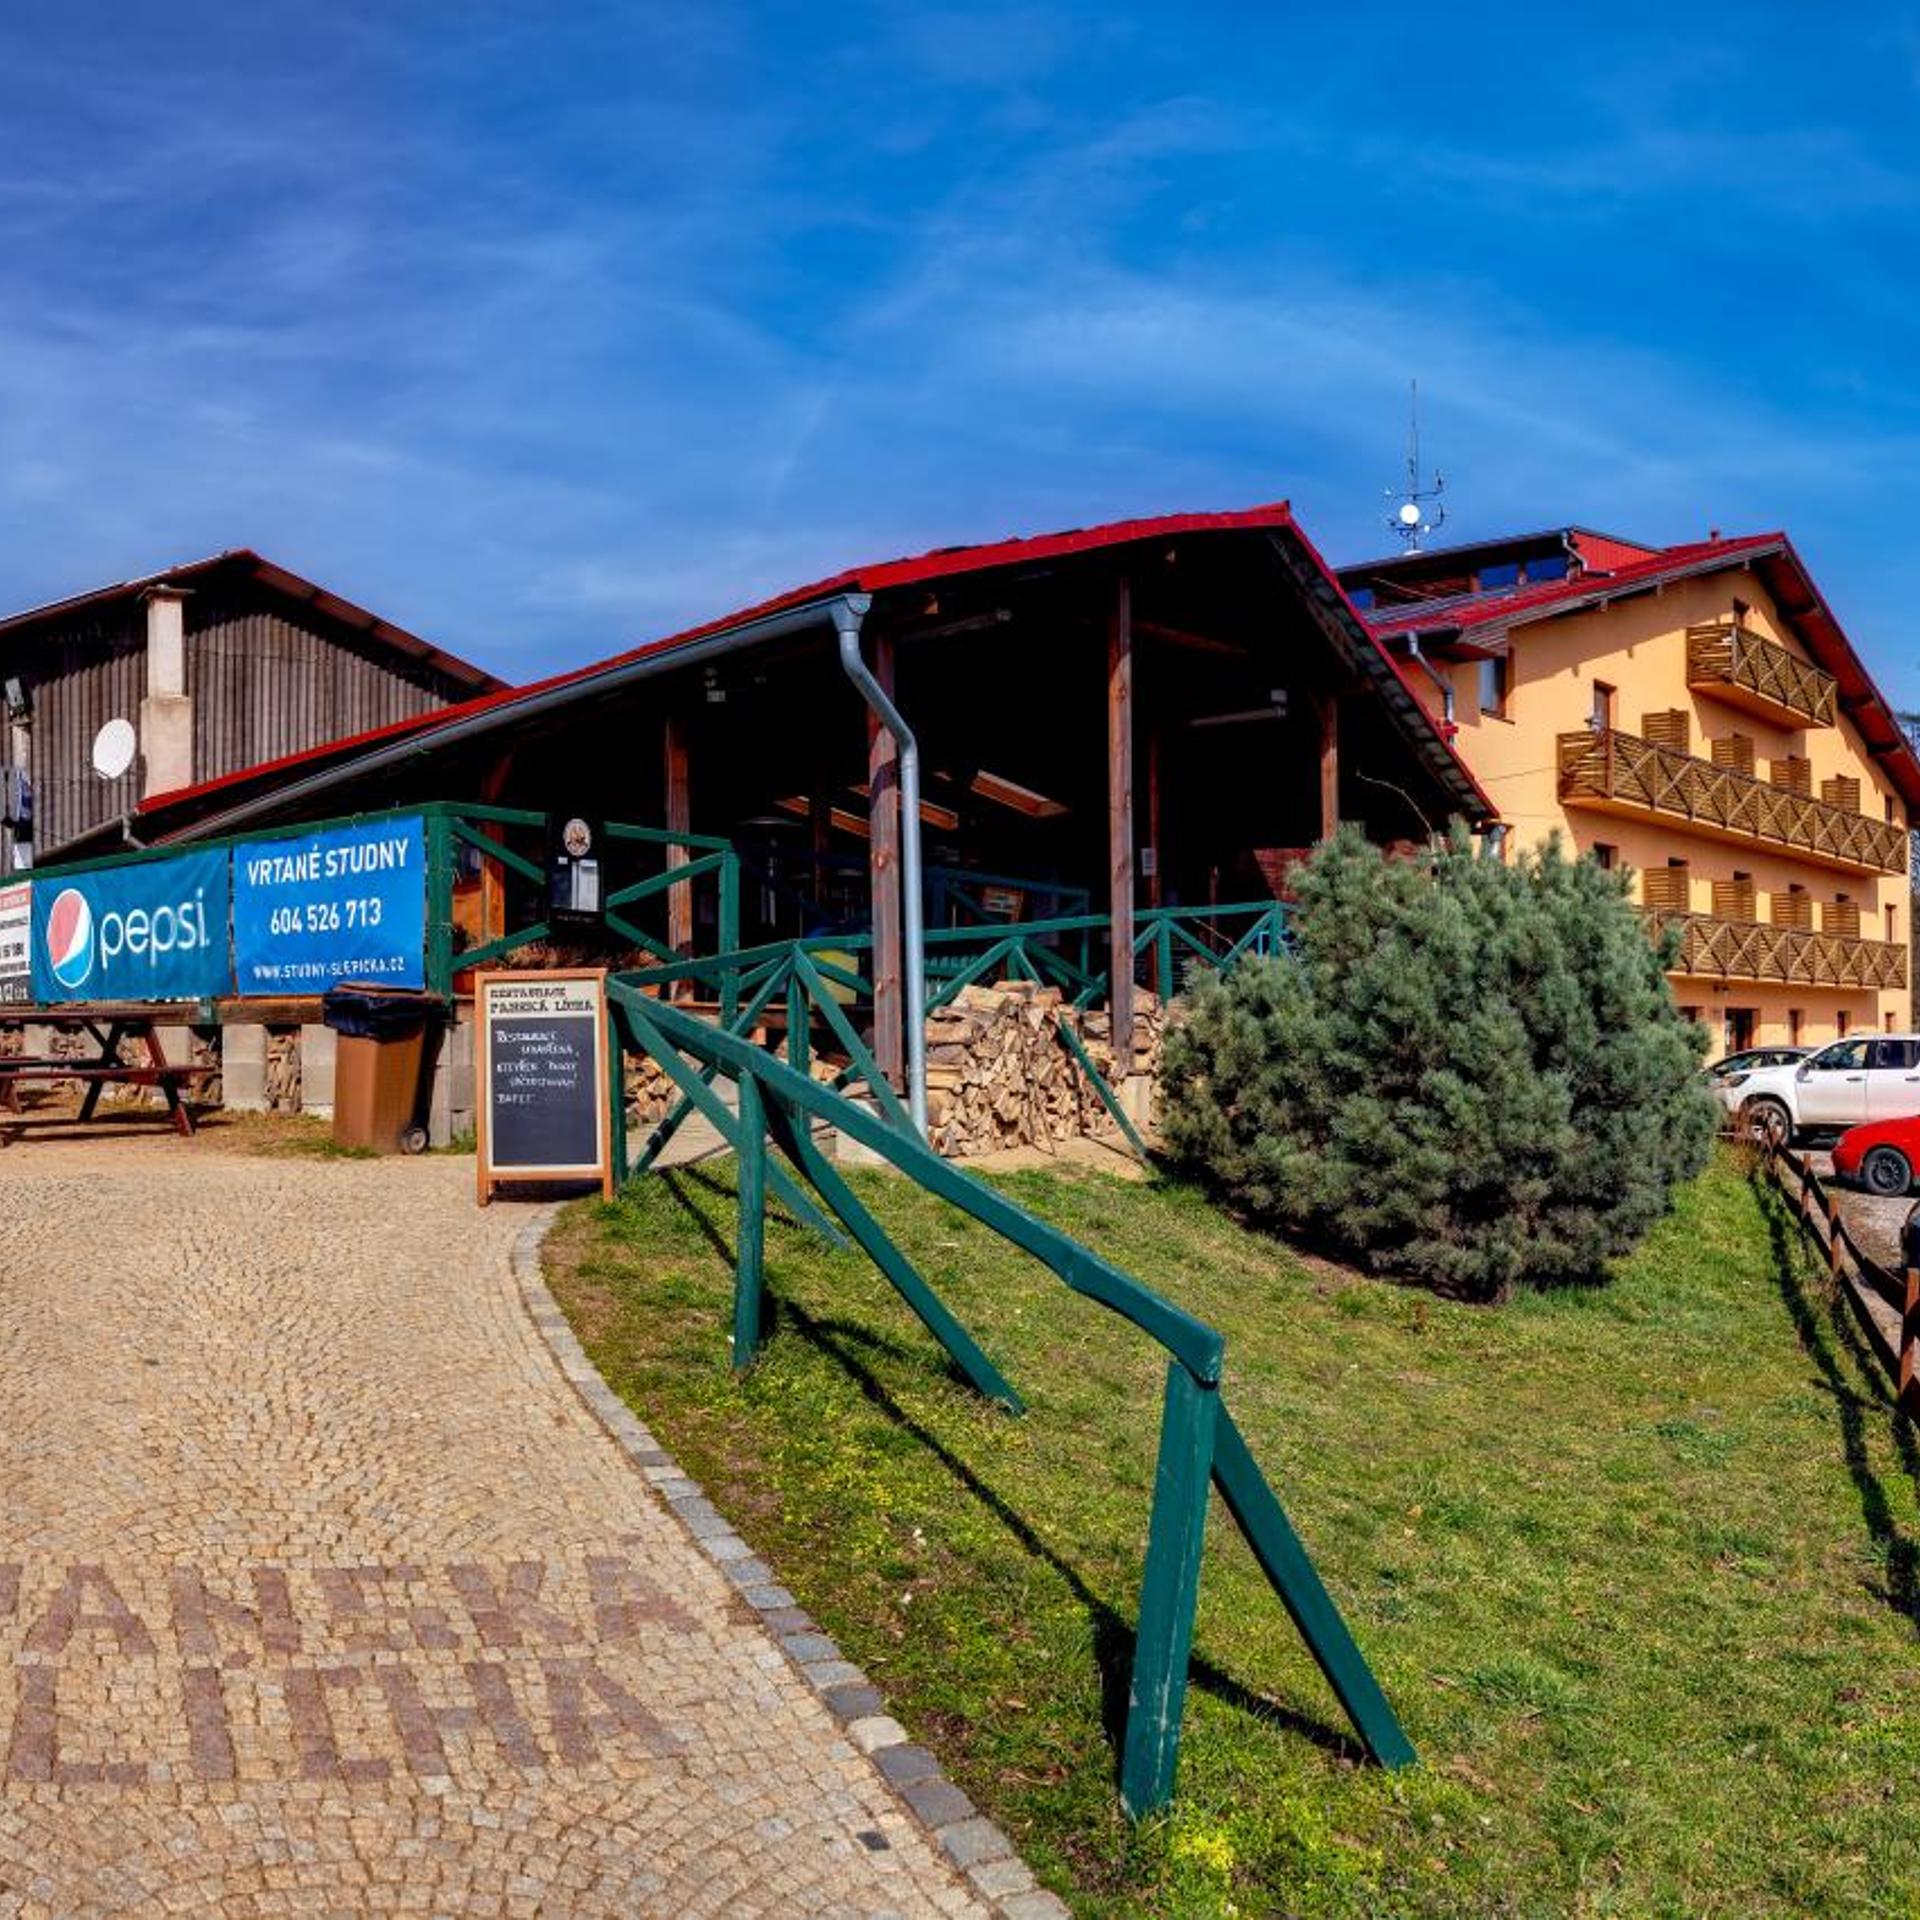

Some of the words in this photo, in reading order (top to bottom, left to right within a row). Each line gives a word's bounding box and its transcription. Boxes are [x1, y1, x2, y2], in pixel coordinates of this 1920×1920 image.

[247, 844, 321, 886] VRTANÉ
[325, 838, 408, 877] STUDNY
[100, 887, 205, 970] pepsi
[271, 906, 302, 935] 604
[307, 902, 340, 932] 526
[346, 897, 382, 927] 713
